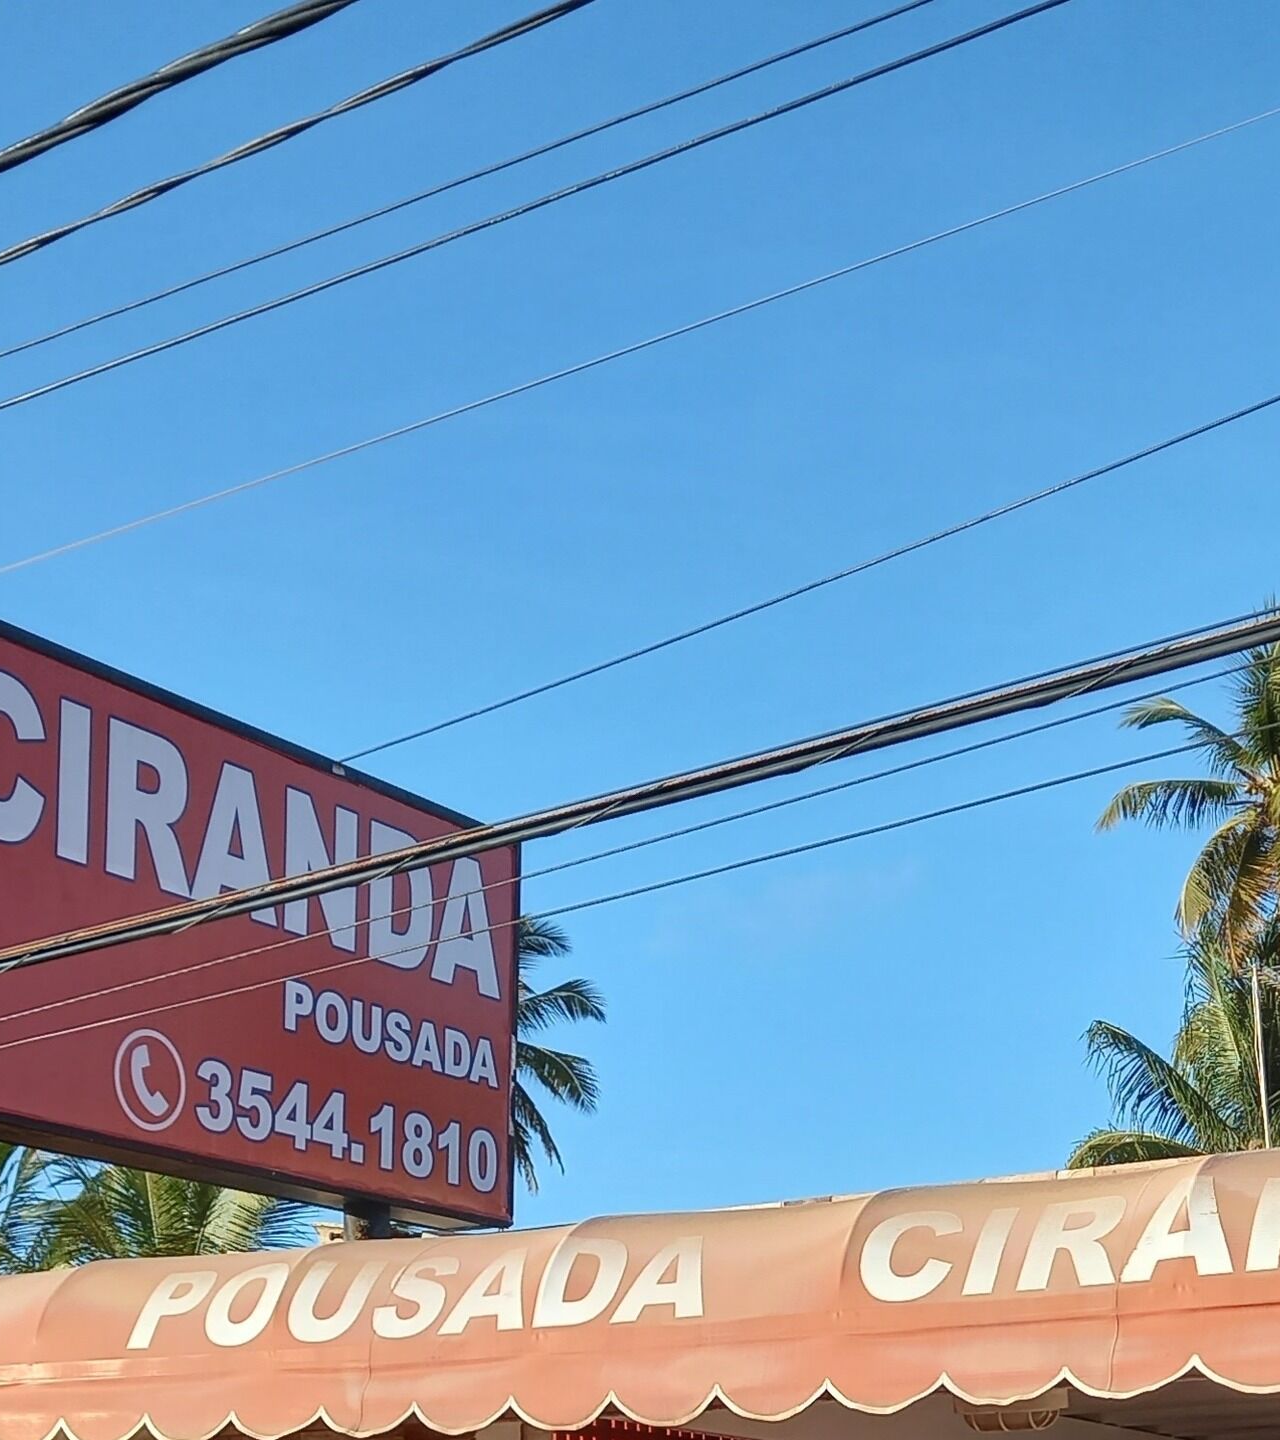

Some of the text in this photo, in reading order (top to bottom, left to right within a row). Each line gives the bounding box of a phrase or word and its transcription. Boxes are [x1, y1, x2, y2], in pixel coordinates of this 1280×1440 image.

[284, 980, 499, 1088] POUSADA
[195, 1060, 498, 1193] 3544.1810
[126, 1235, 705, 1350] POUSADA
